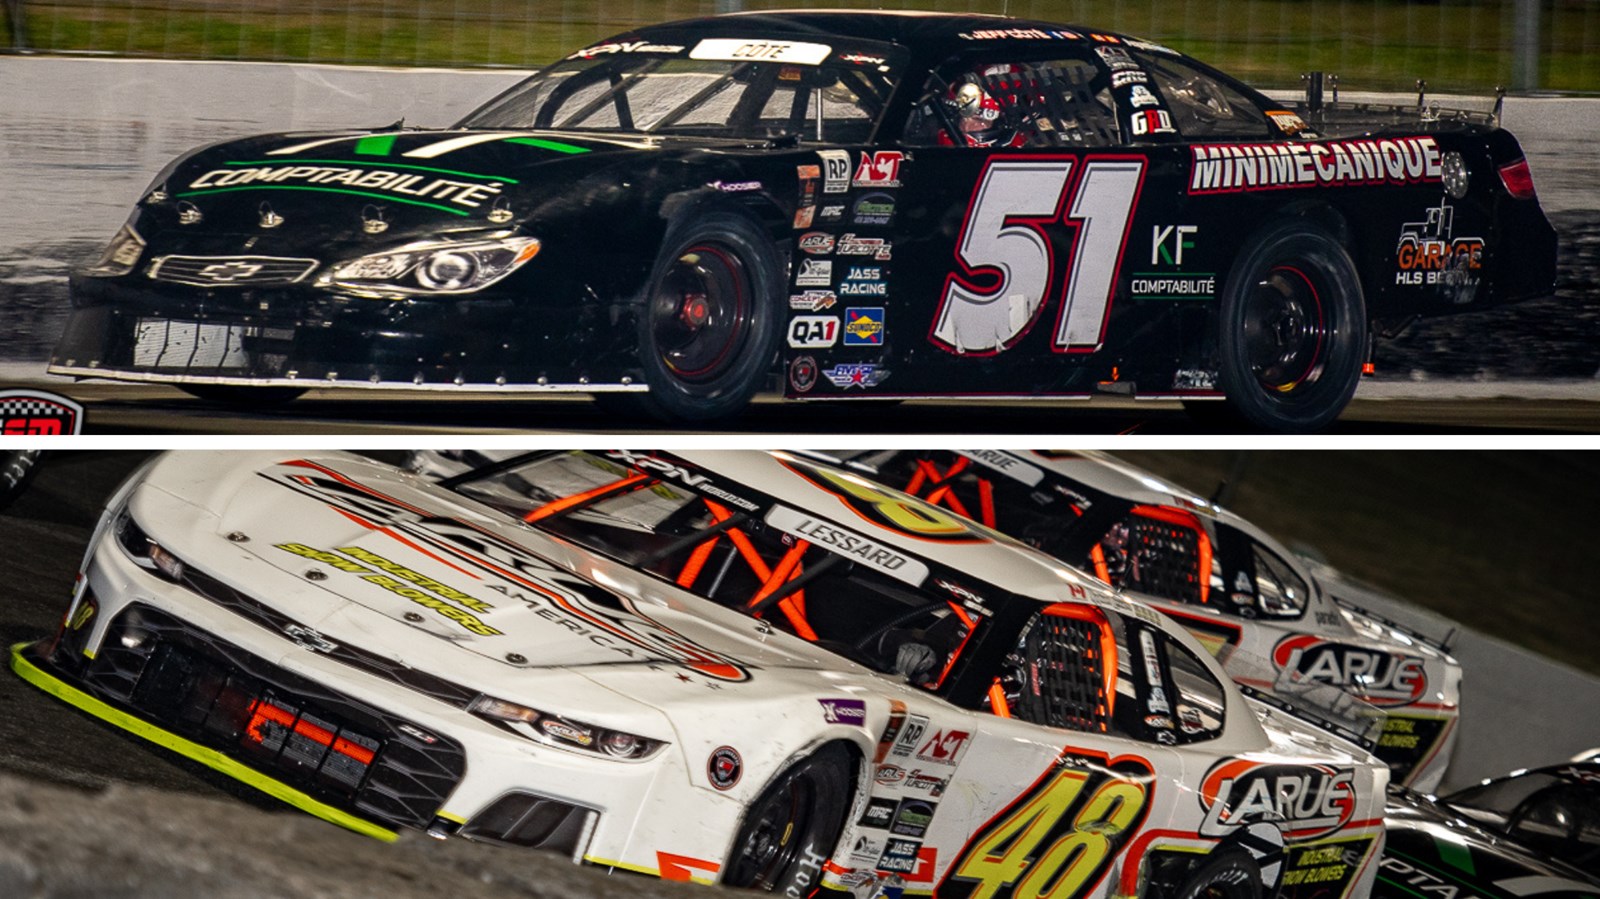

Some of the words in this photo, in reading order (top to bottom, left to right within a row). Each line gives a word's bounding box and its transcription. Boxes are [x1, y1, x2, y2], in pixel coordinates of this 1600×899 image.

[189, 165, 504, 208] COMPTABILITÉ
[828, 159, 848, 179] RP
[929, 153, 1148, 355] 51
[1151, 224, 1199, 266] KF
[840, 283, 886, 295] RACING
[847, 268, 880, 280] JASS
[1131, 276, 1216, 294] COMPTABILITÉ
[1395, 271, 1423, 285] HLS
[792, 320, 836, 345] QA1
[795, 519, 907, 571] LESSARD
[332, 545, 496, 614] INDUSTRIAL
[358, 573, 506, 637] BLOWERS
[485, 584, 635, 658] AMERICA
[901, 724, 924, 744] RP
[1198, 768, 1355, 838] LARUE
[943, 760, 1150, 899] 48
[879, 857, 914, 871] RACING
